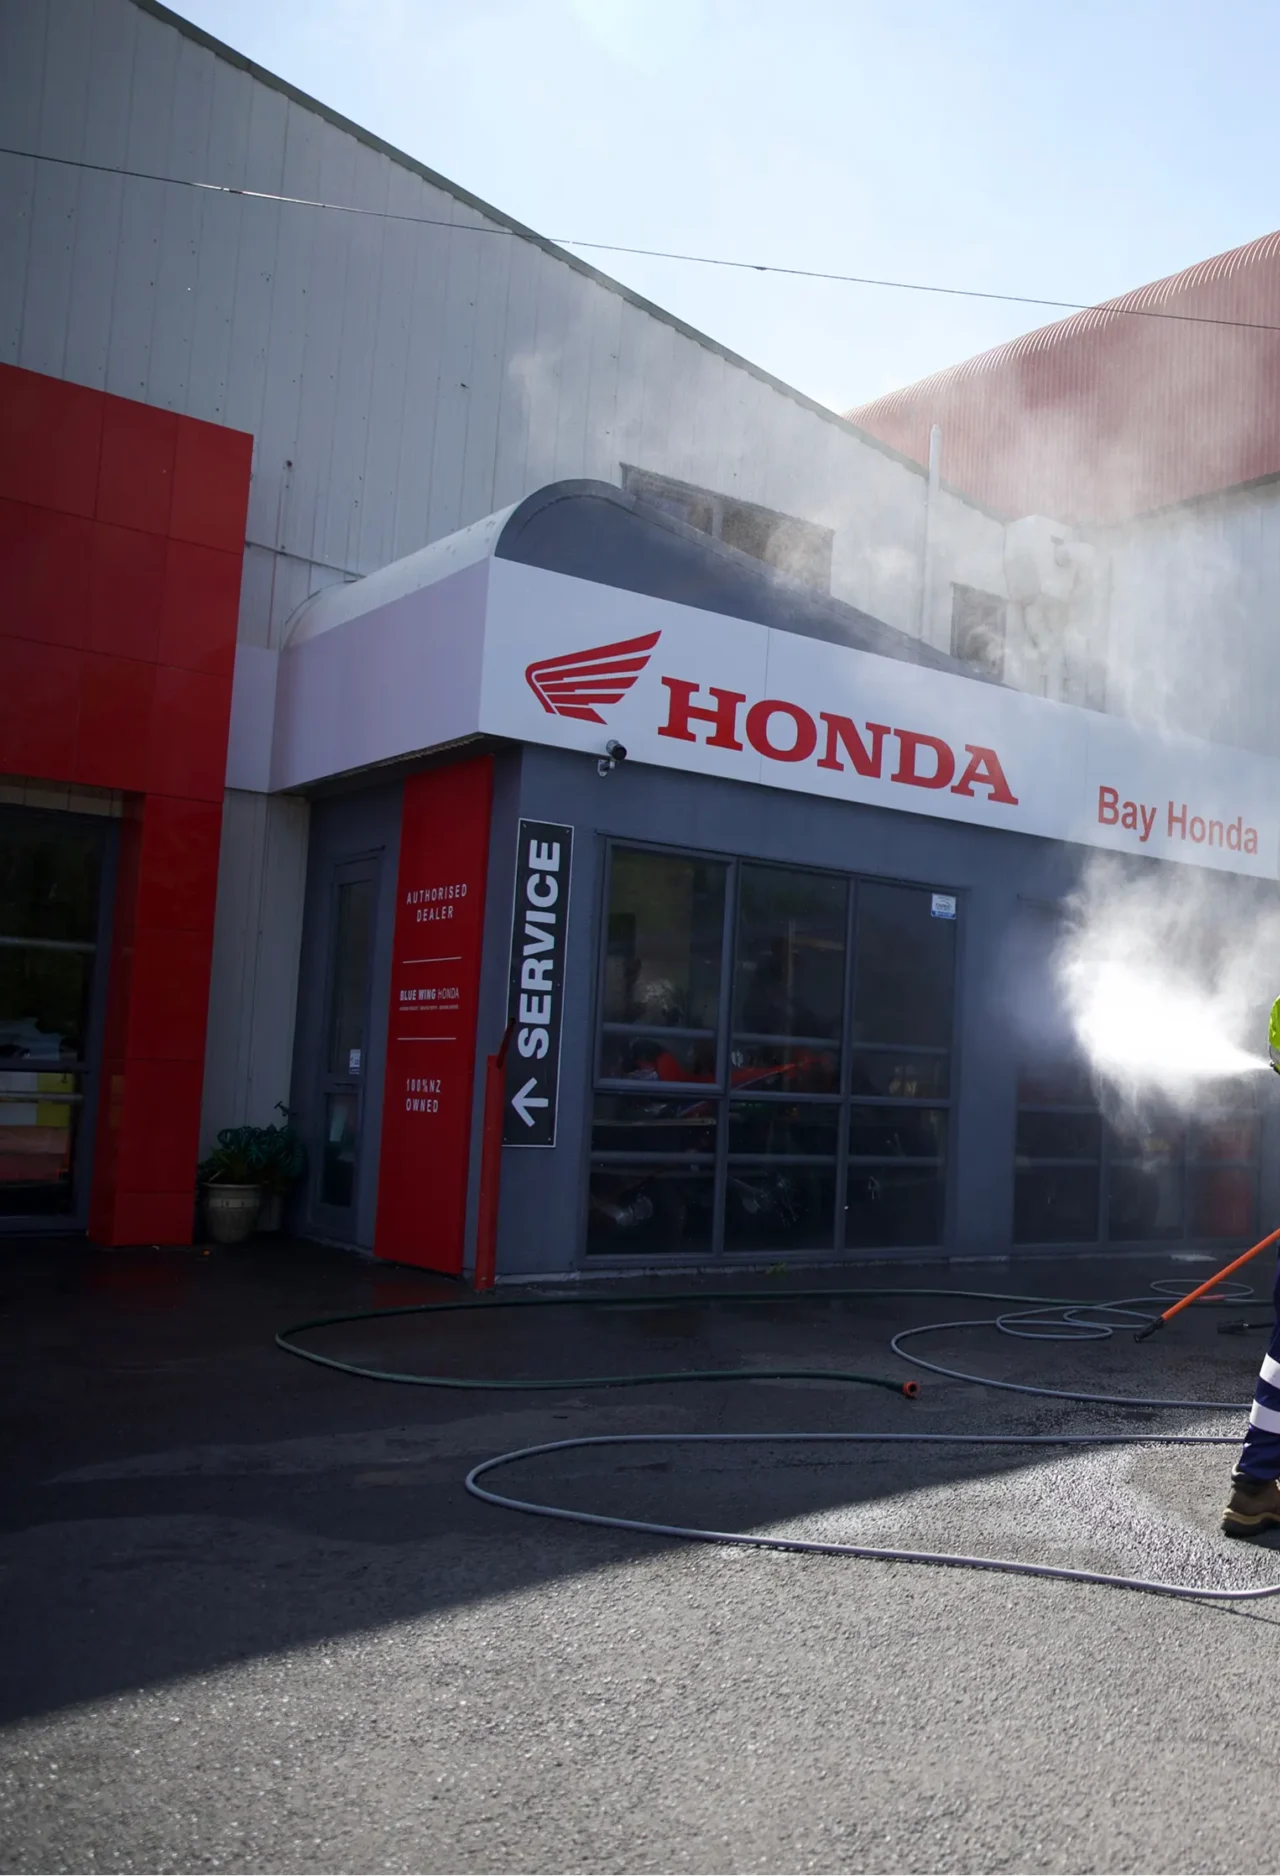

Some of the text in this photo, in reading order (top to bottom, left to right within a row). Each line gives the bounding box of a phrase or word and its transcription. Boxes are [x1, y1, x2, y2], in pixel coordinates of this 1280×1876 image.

[657, 676, 1019, 806] HONDA
[1098, 785, 1258, 854] Bay Honda
[406, 884, 467, 904] AUTHORISED
[417, 906, 454, 922] DEALER
[517, 839, 561, 1059] SERVICE
[400, 987, 459, 1001] BLUE WING HONDA
[406, 1098, 439, 1113] OWNED
